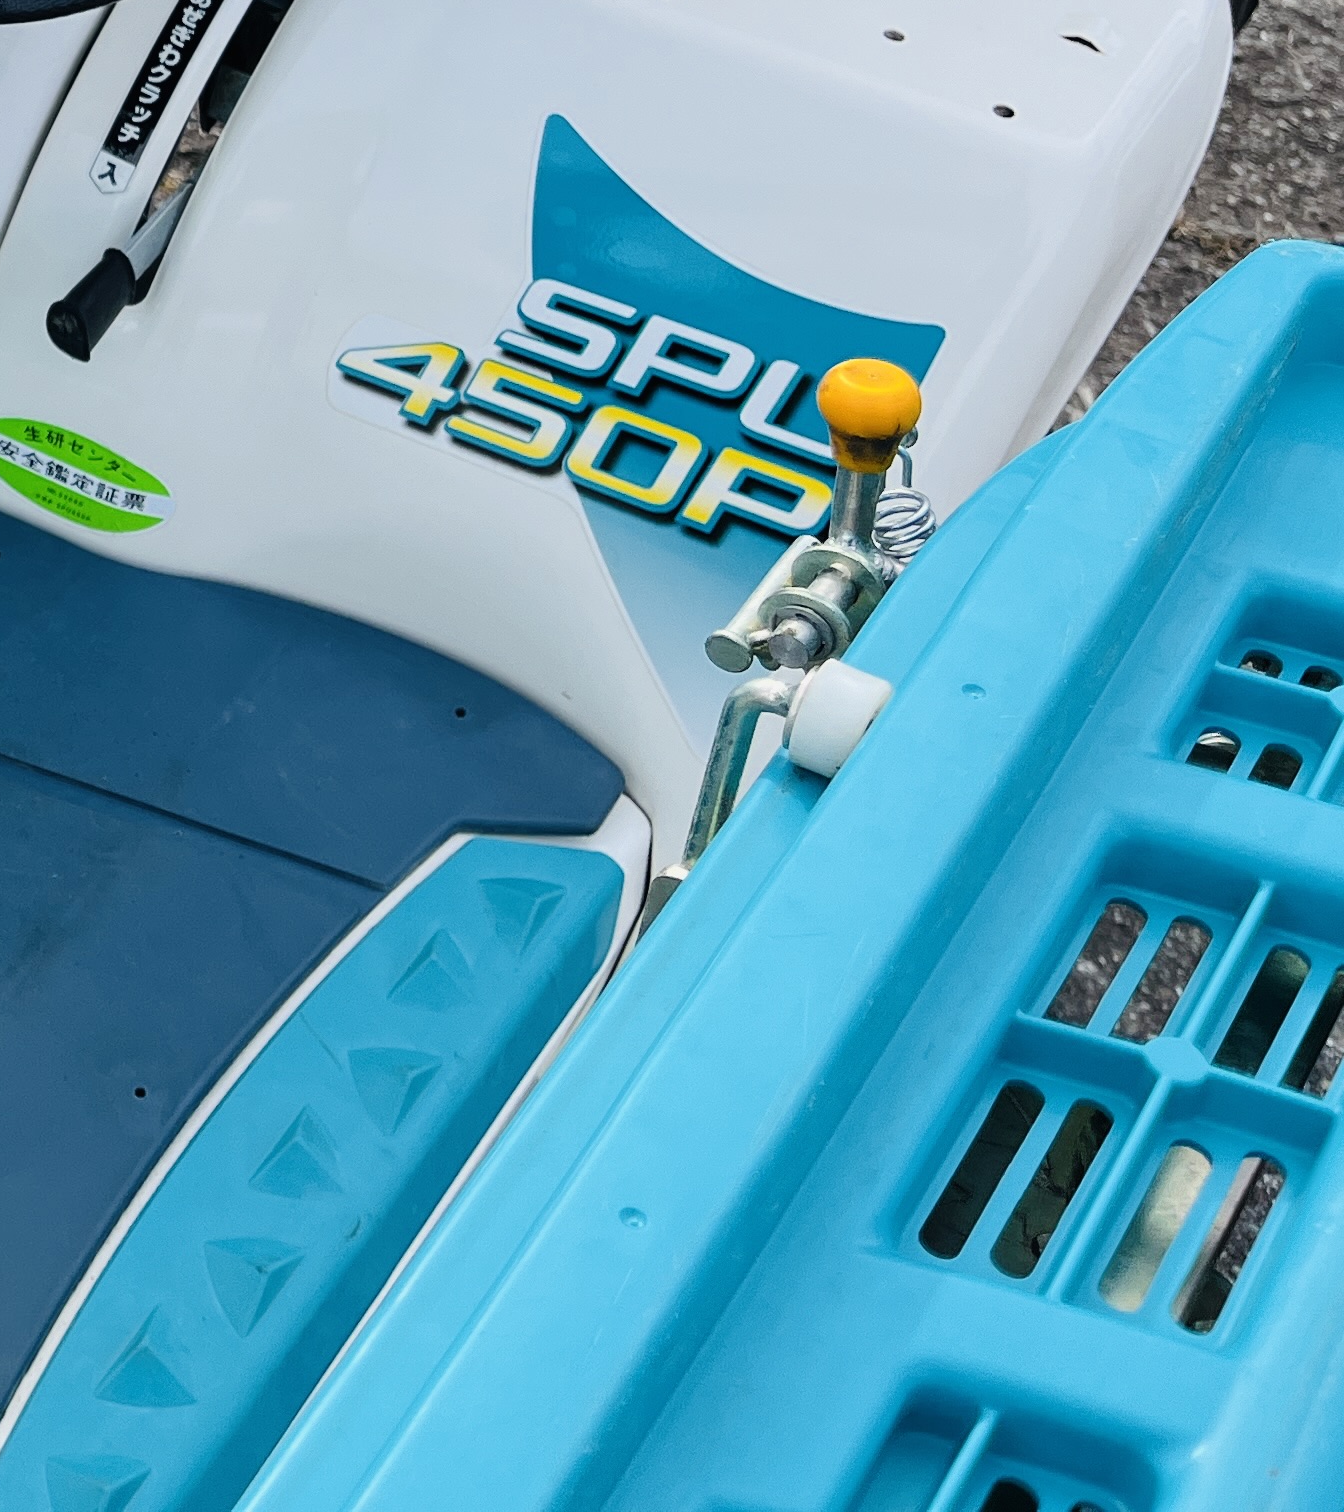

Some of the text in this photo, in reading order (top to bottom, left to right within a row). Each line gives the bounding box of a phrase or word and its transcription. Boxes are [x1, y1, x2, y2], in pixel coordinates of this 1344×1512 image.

[97, 161, 118, 186] 入
[23, 425, 137, 483] 生研センター
[336, 340, 836, 535] 450P
